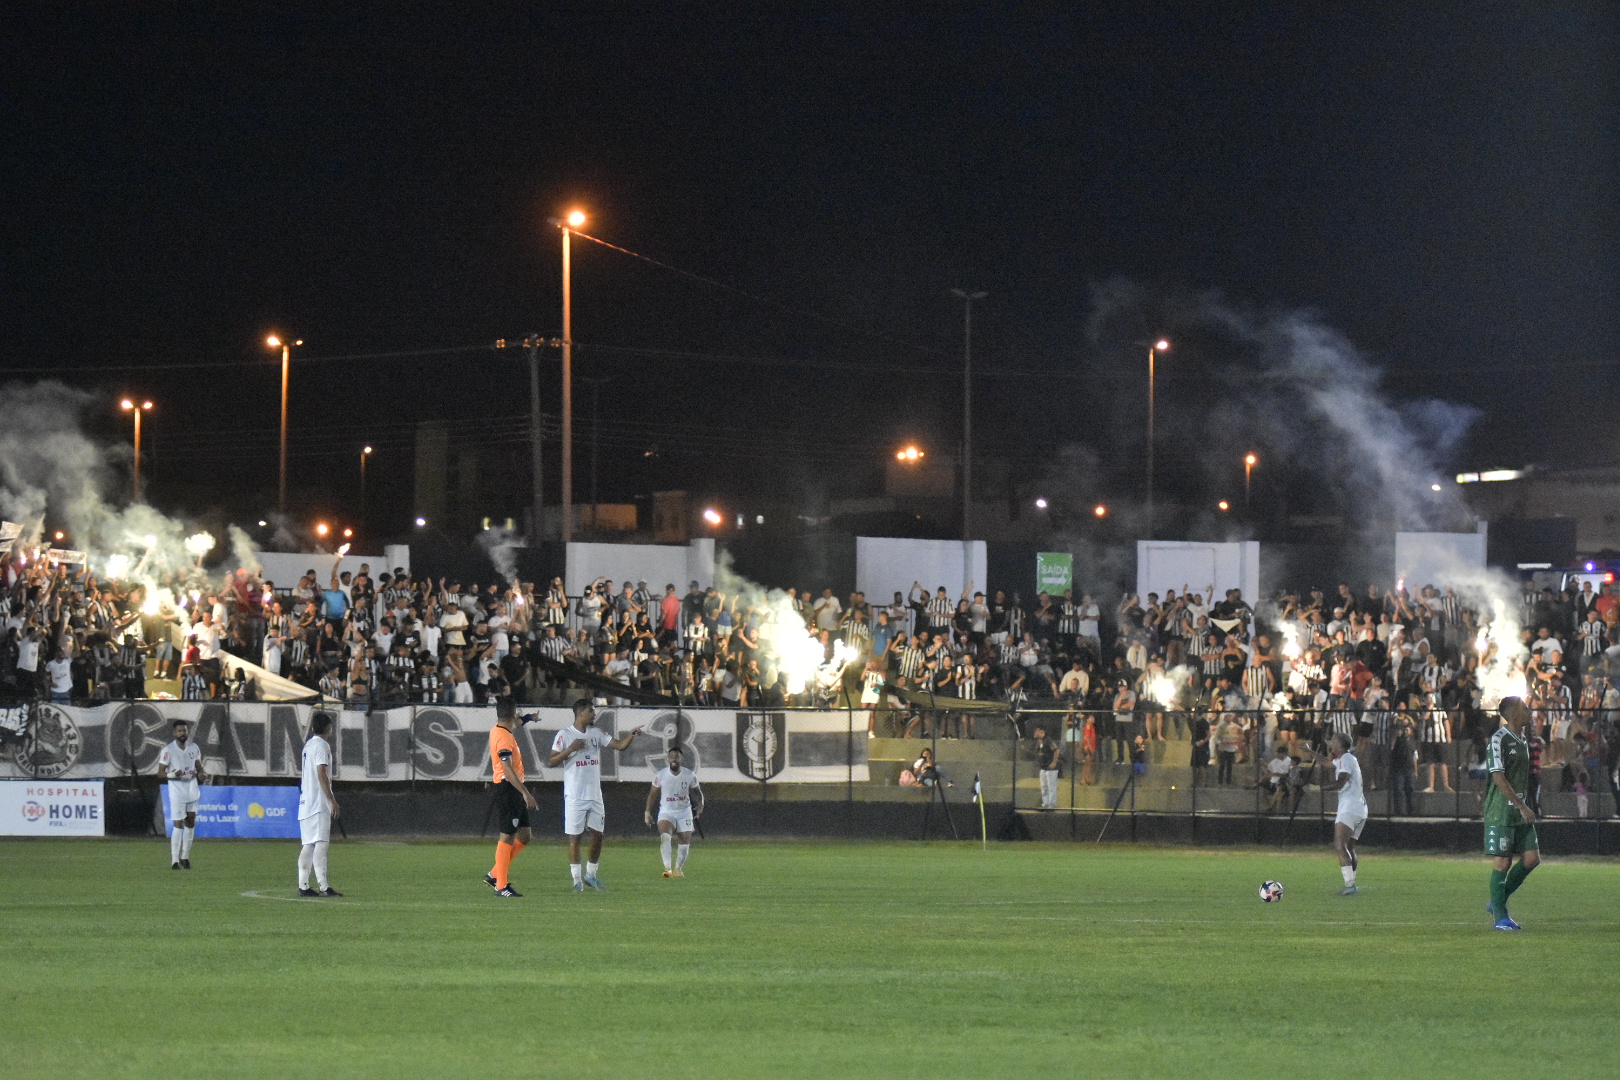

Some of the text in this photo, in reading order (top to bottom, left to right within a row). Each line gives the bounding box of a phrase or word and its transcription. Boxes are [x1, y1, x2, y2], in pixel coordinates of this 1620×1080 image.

[104, 702, 544, 779] CAMISA
[27, 788, 98, 797] HOSPITAL
[49, 804, 99, 819] HOME
[265, 808, 287, 817] GDF
